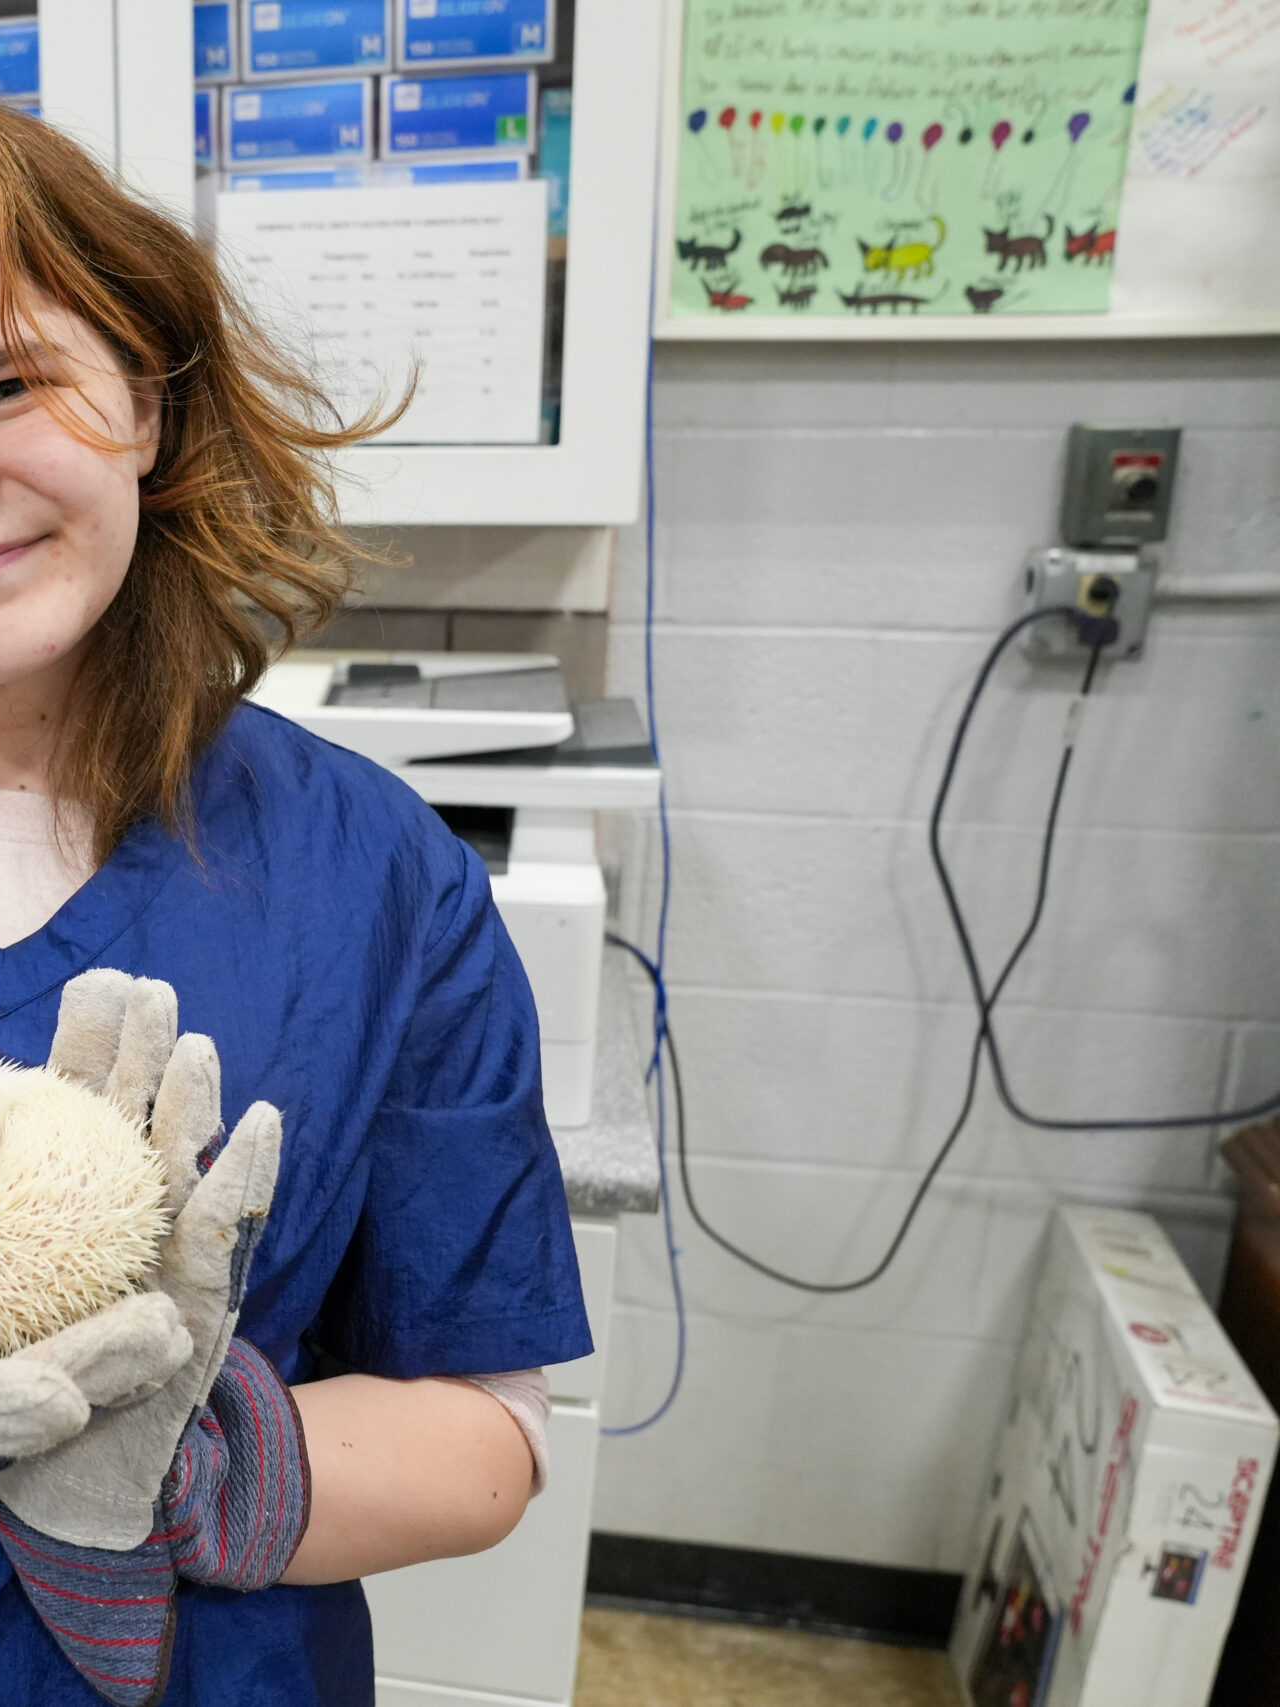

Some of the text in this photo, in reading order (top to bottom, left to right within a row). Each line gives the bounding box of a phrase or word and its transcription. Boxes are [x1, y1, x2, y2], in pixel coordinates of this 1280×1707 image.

[361, 35, 382, 56] M
[522, 24, 542, 46] M
[206, 48, 226, 66] M
[339, 126, 360, 146] M
[506, 117, 518, 139] L
[1178, 1482, 1225, 1531] 24
[1210, 1457, 1260, 1571] SCEPTRE
